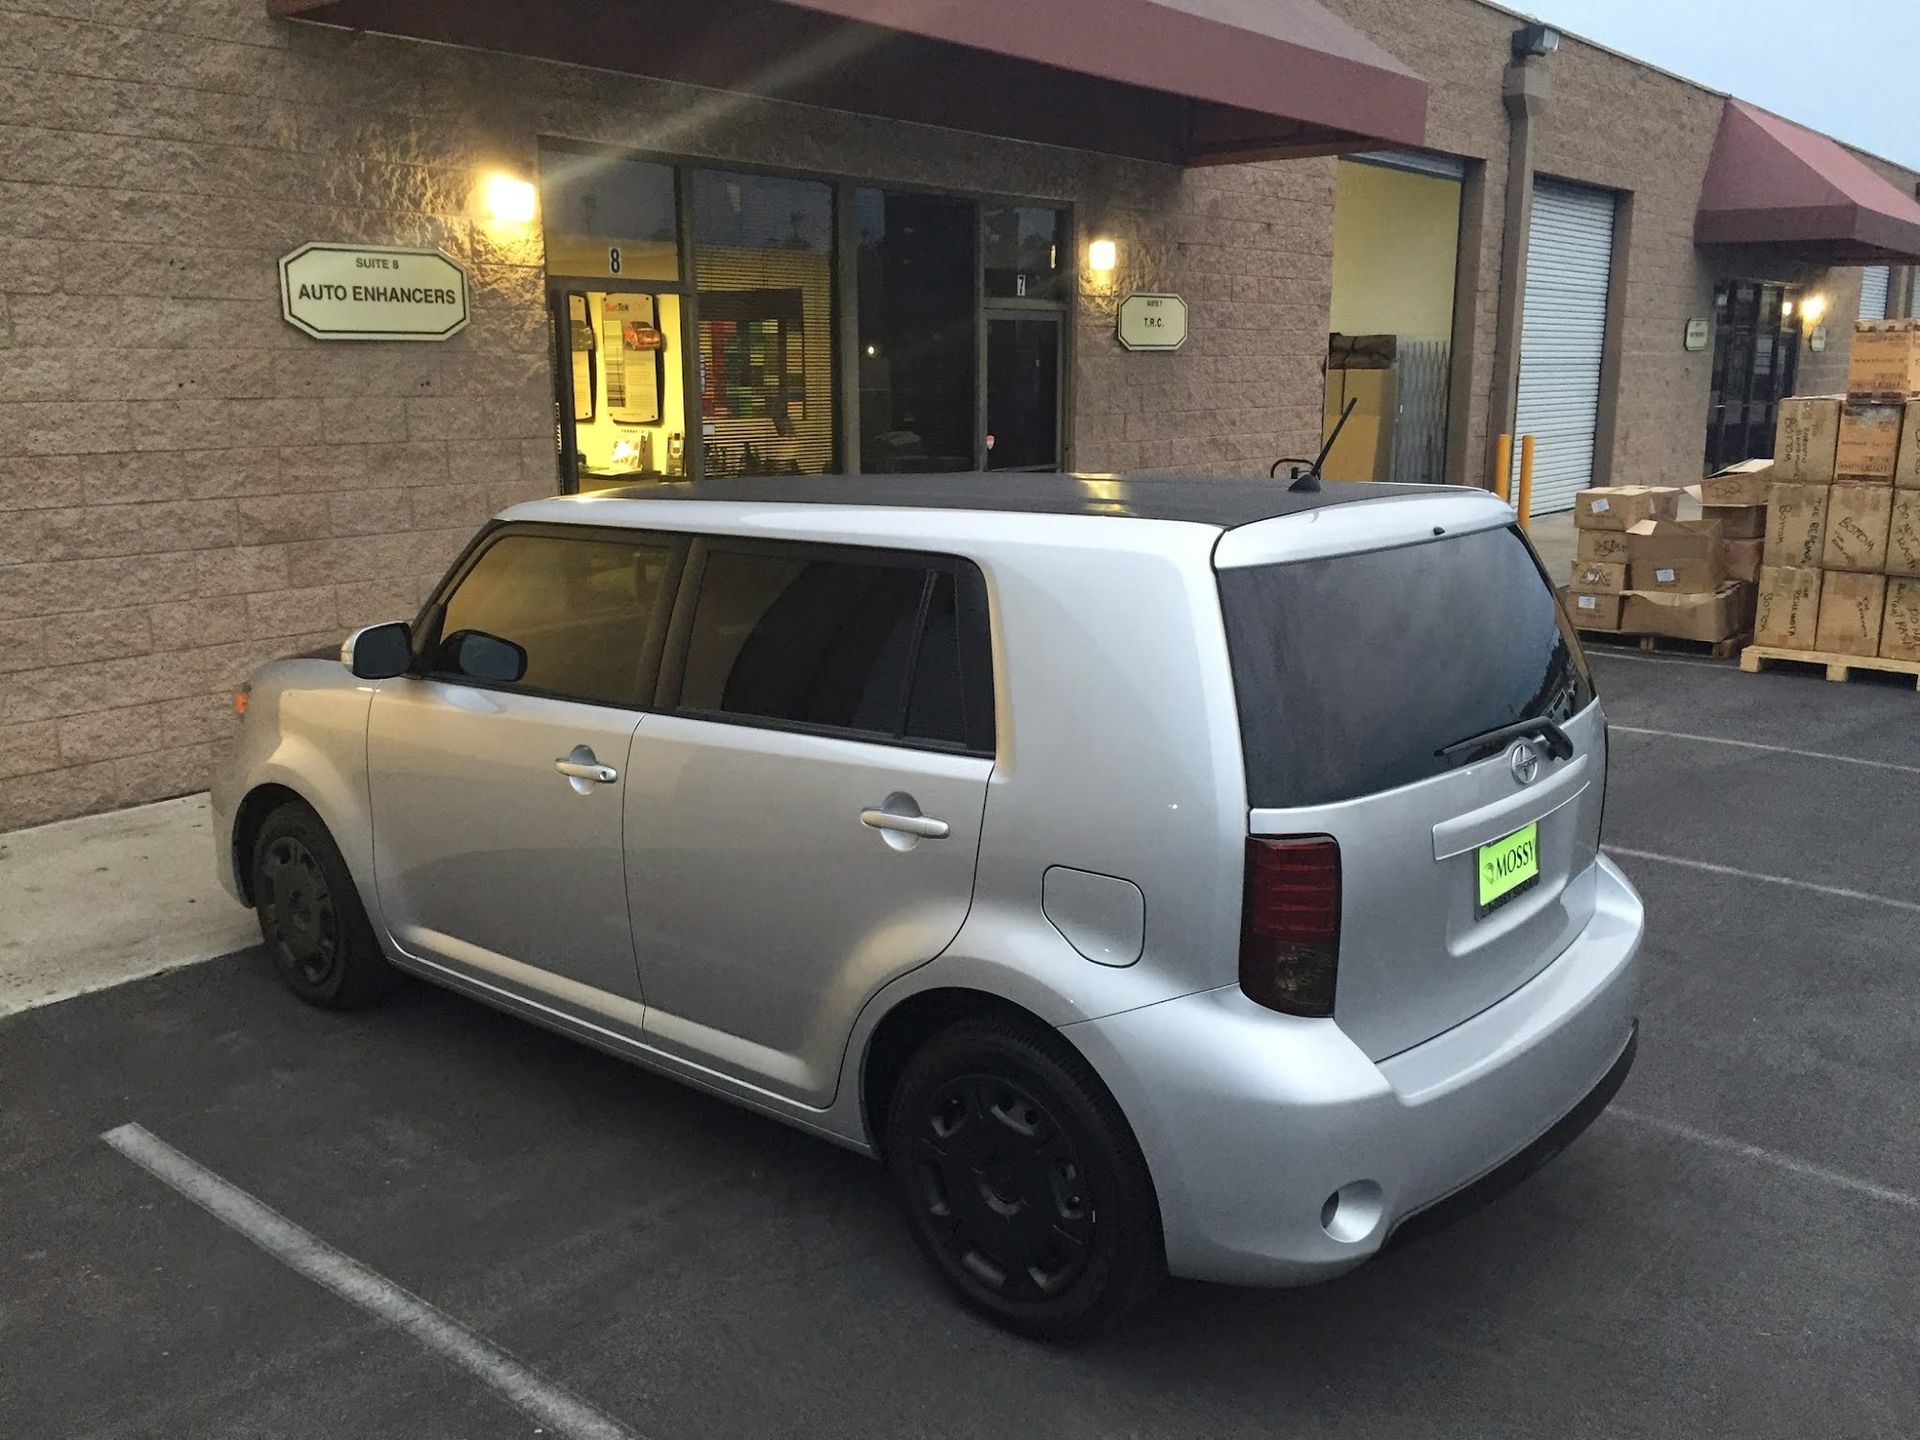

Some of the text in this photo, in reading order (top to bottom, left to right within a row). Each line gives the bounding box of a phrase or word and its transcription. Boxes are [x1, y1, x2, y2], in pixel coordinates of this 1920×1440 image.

[356, 257, 389, 269] SUITE
[610, 248, 620, 273] 8
[299, 284, 456, 304] AUTO ENHANCERS
[1018, 276, 1025, 295] 7
[1496, 839, 1536, 880] MOSSY
